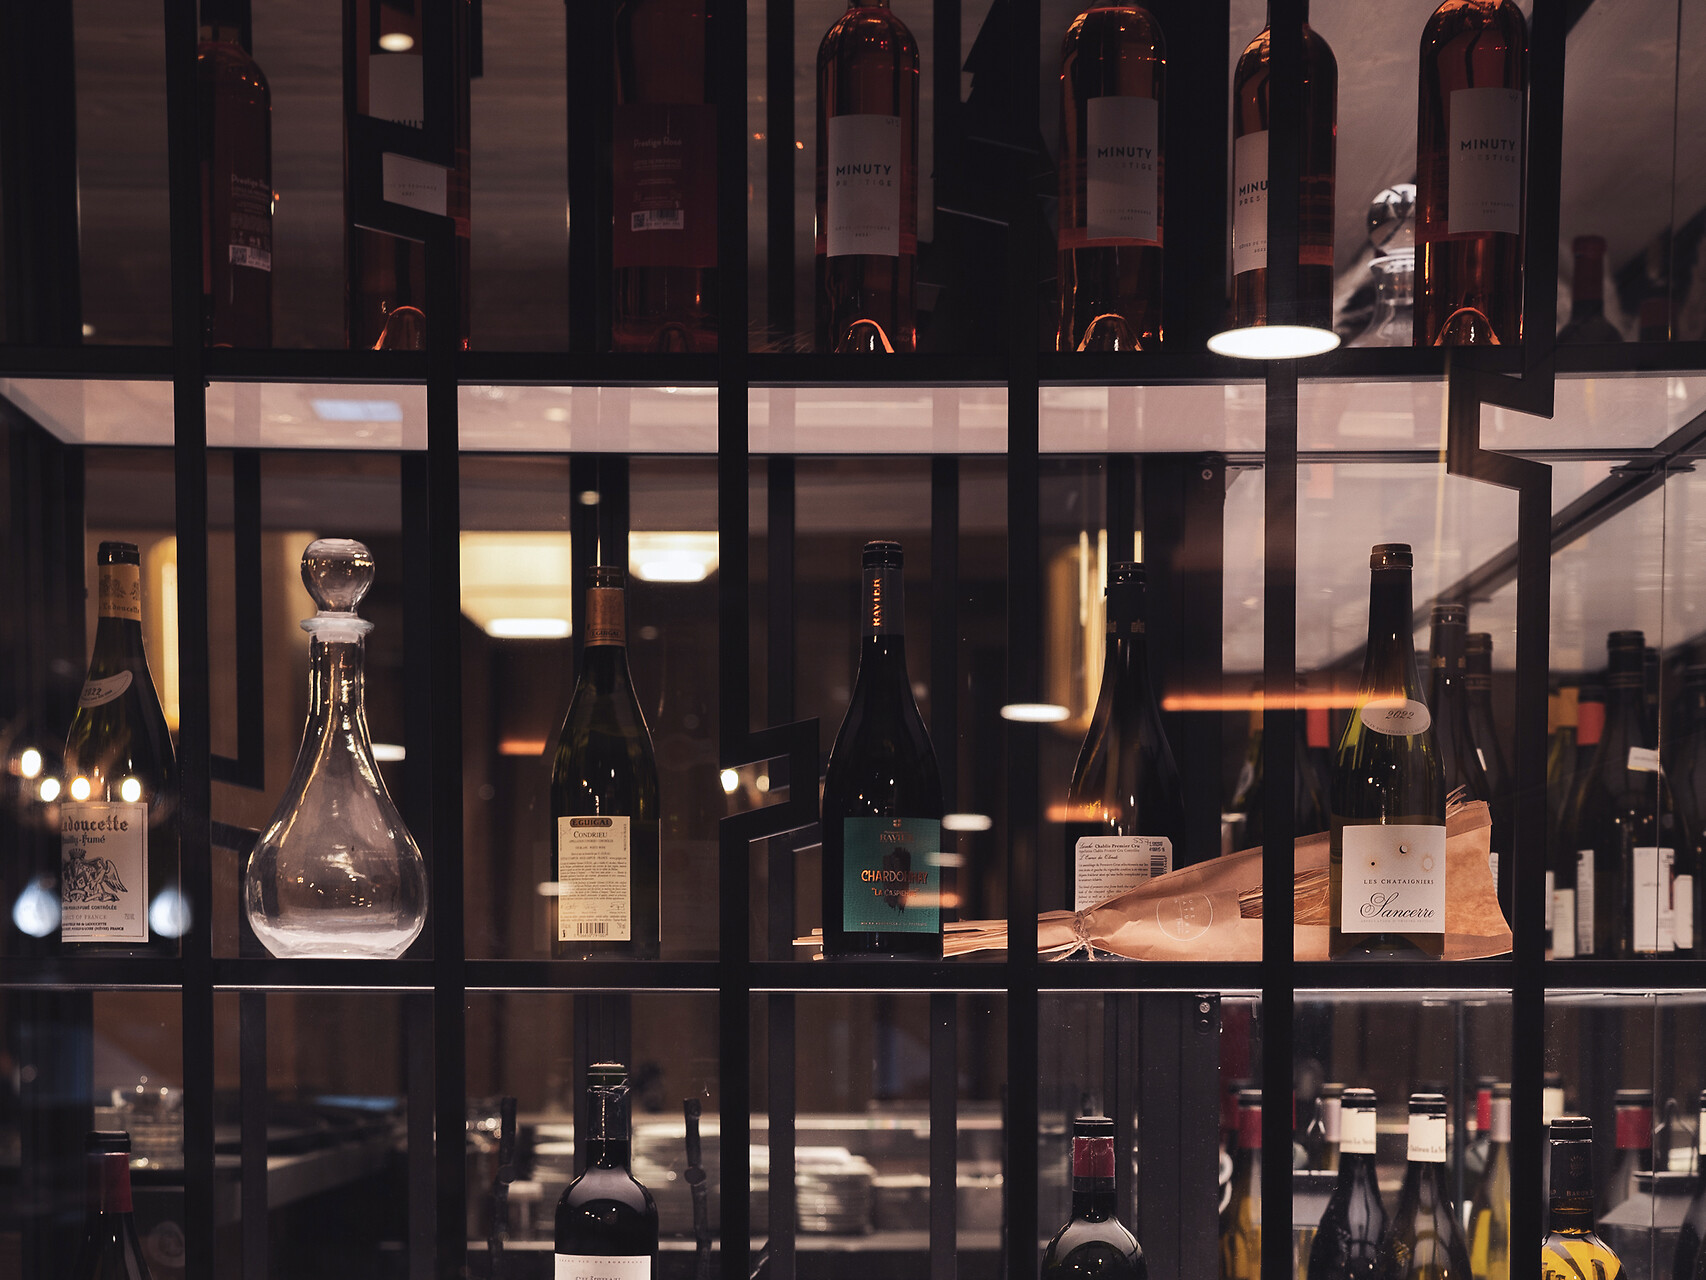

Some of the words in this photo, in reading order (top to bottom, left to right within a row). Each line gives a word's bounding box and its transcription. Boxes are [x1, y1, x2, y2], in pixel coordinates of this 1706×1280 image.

[1460, 138, 1516, 152] MINUTY
[1097, 146, 1153, 160] MINUTY
[835, 163, 892, 177] MINUTY
[1239, 180, 1269, 197] MINU
[1384, 710, 1416, 720] 2022
[62, 814, 129, 832] adoucette
[573, 830, 609, 839] CONDRIEU
[861, 869, 929, 884] CHARDONNAY
[1360, 892, 1436, 919] Sancerre
